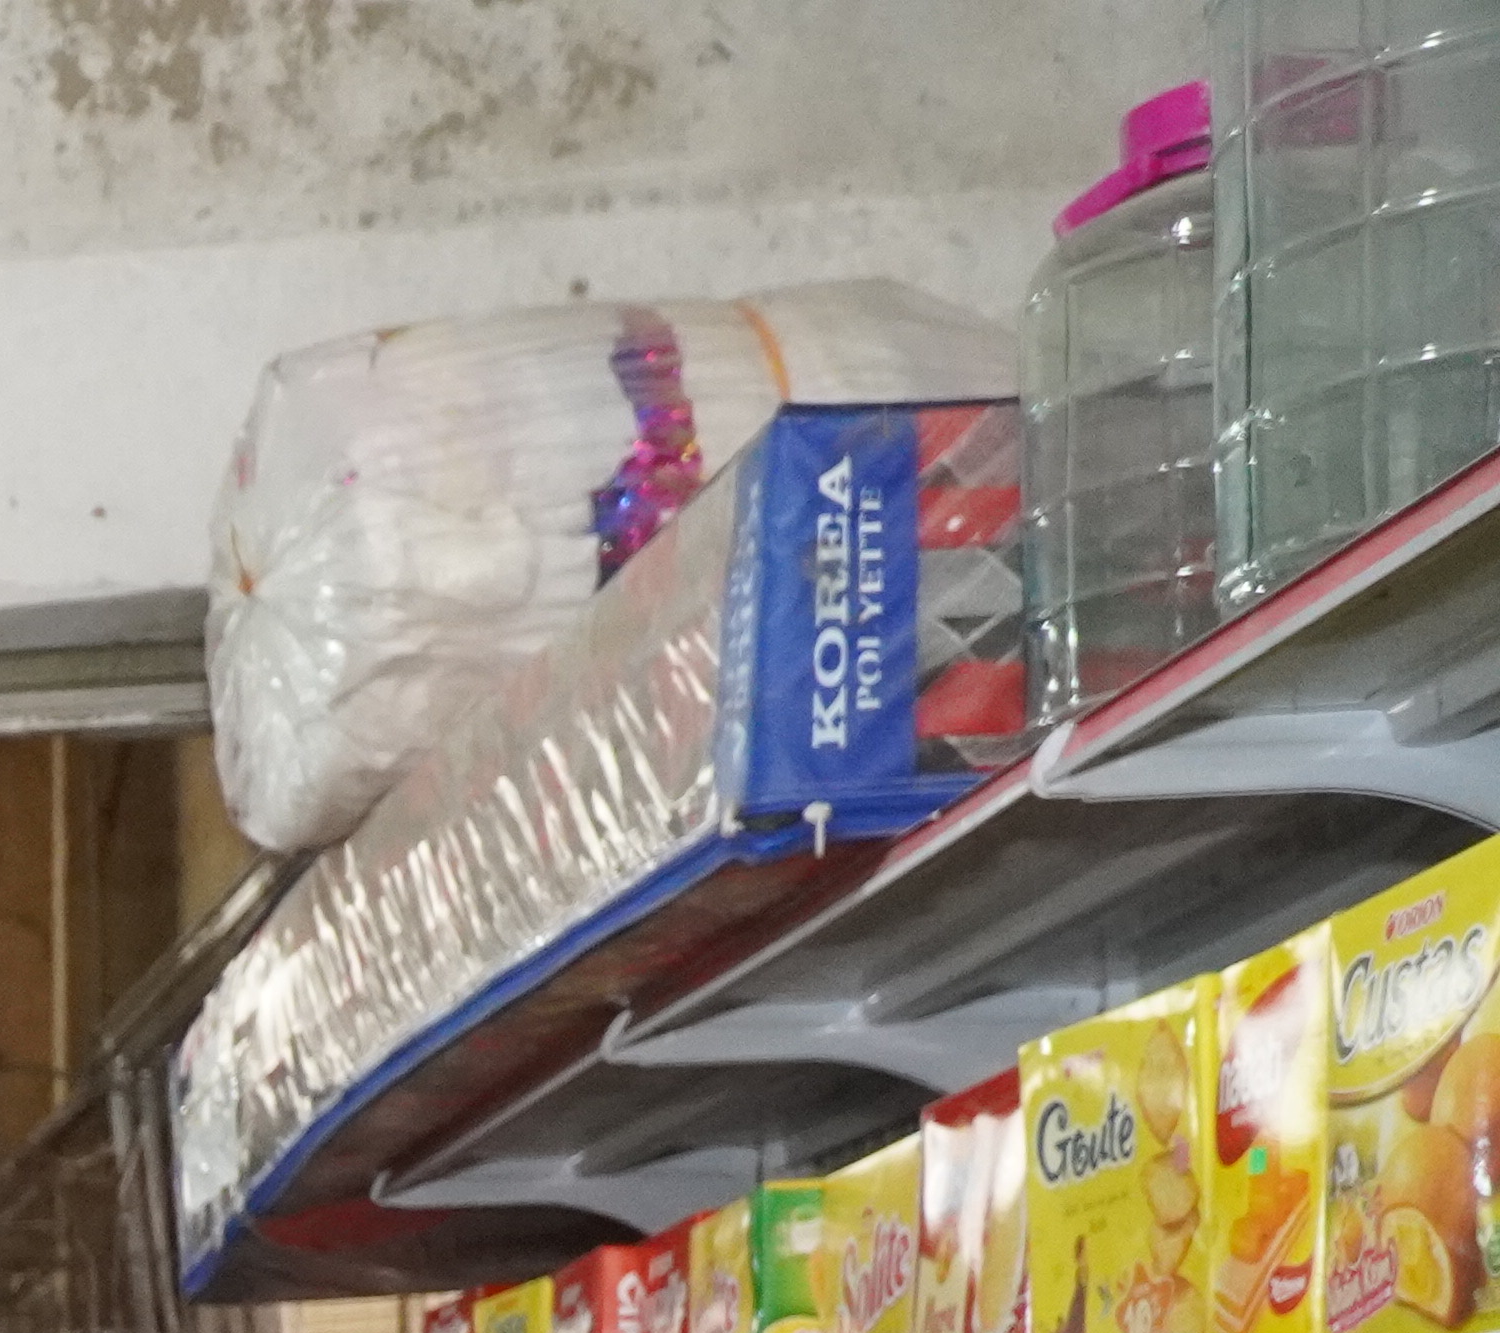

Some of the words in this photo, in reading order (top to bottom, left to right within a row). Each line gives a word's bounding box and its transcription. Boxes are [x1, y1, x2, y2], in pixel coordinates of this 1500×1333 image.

[812, 453, 852, 749] KOREA
[1337, 926, 1485, 1062] Custas
[1037, 1092, 1135, 1185] Gouté
